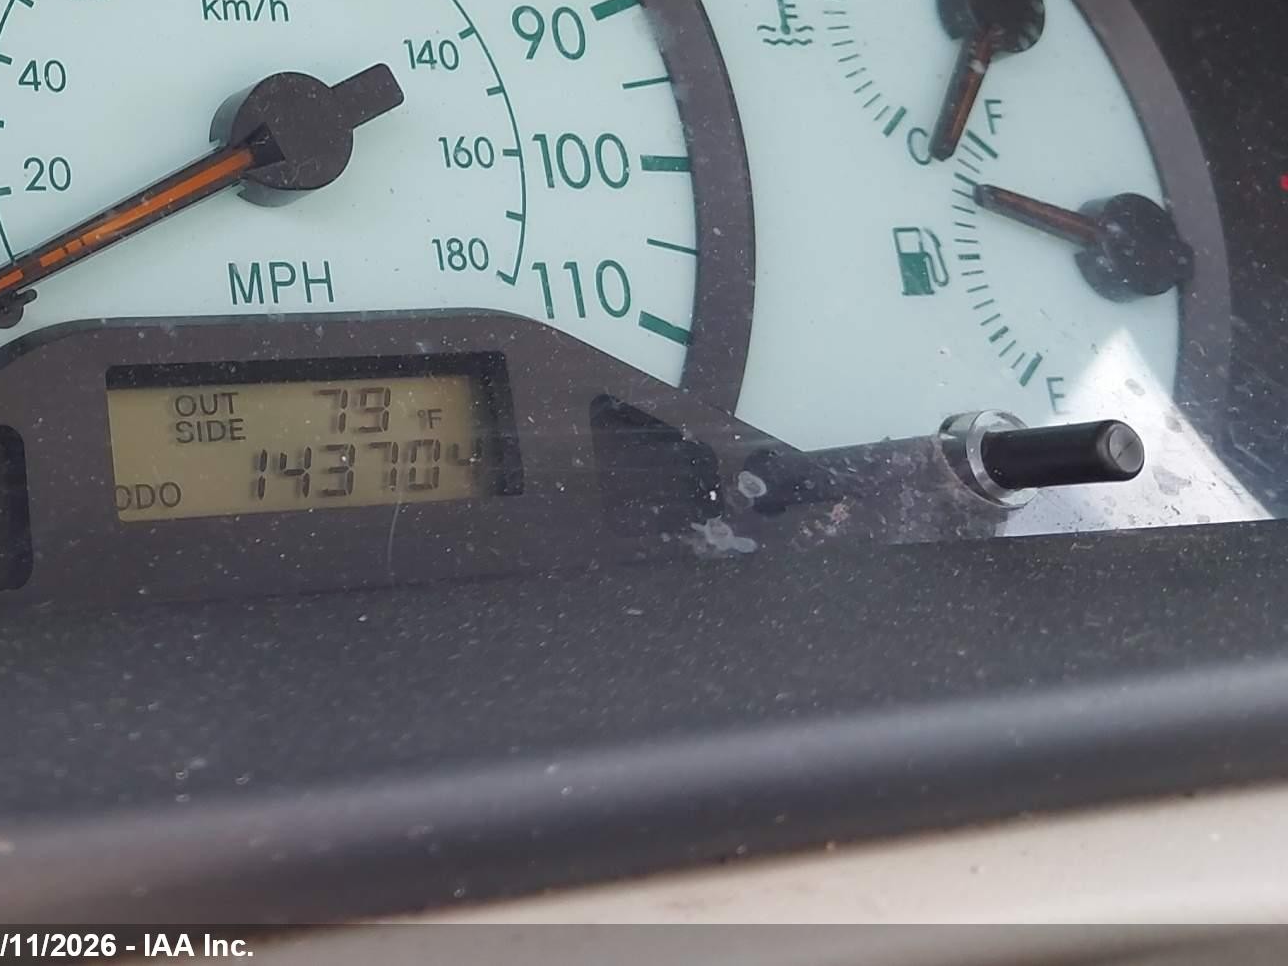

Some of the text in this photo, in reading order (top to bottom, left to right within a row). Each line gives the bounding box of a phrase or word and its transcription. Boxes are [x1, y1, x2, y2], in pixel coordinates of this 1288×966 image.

[512, 6, 585, 60] 90
[404, 40, 459, 70] 140
[19, 60, 66, 92] 40
[984, 99, 1002, 134] F
[439, 136, 494, 168] 160
[532, 133, 629, 189] 100
[907, 127, 933, 166] C
[24, 157, 71, 191] 20
[432, 238, 489, 271] 180
[228, 261, 334, 305] MPH
[532, 260, 631, 319] 110
[176, 393, 239, 417] OUT
[319, 387, 390, 434] 79
[176, 419, 246, 444] SIDE
[113, 481, 182, 511] ODO
